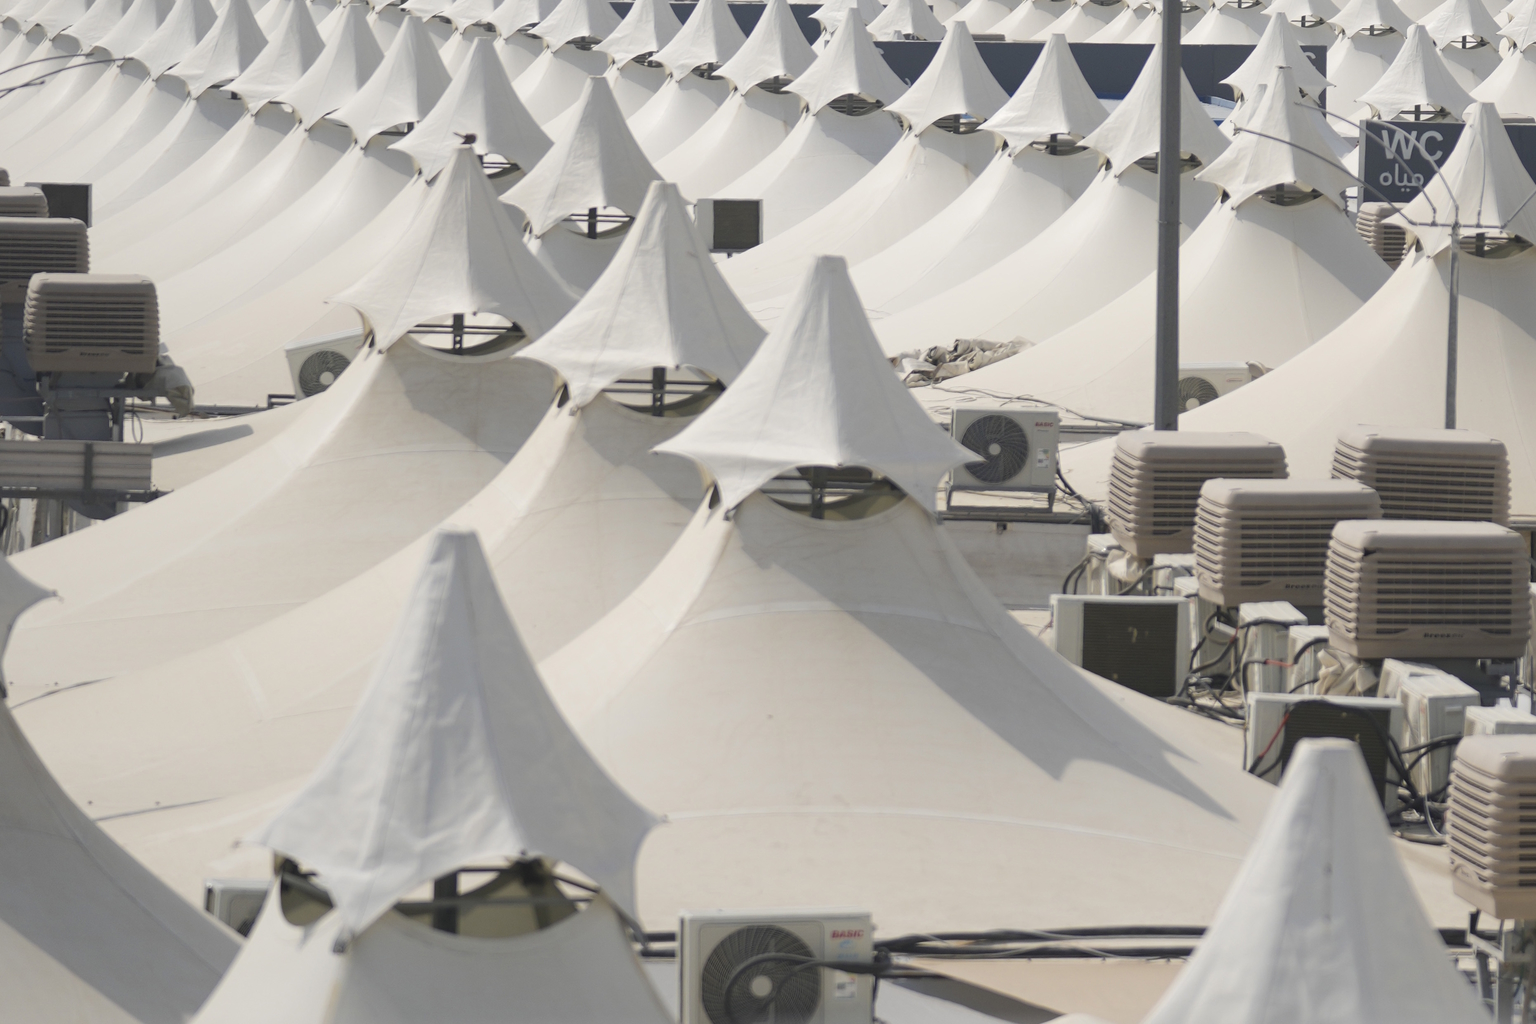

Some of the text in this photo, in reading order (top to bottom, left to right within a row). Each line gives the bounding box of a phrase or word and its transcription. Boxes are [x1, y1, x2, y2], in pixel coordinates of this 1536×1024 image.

[1381, 130, 1444, 161] WC
[1379, 163, 1424, 192] مياه
[831, 929, 864, 938] BASIC
